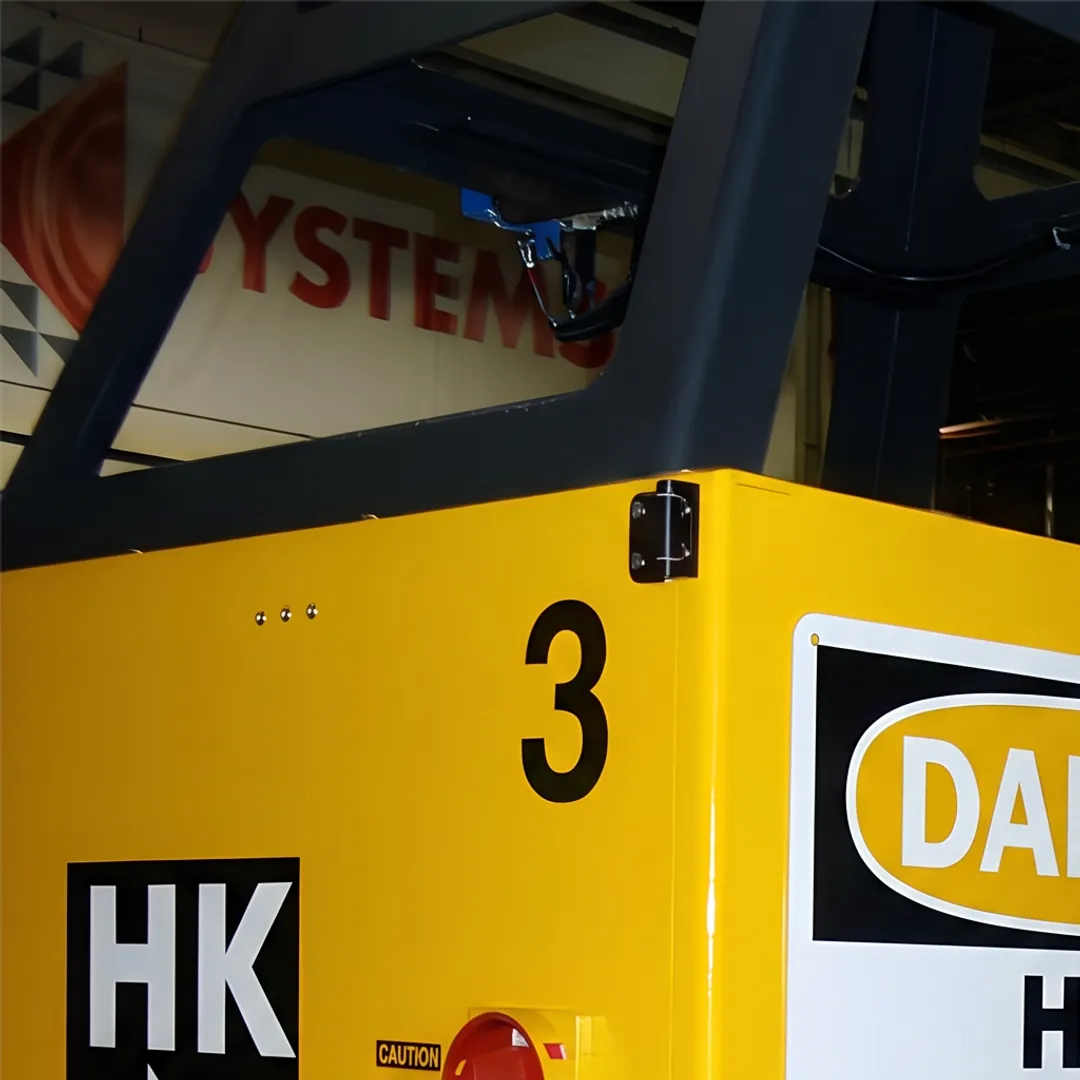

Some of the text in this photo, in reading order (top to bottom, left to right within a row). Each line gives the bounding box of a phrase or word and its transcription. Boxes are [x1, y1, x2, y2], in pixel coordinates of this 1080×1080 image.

[521, 599, 608, 803] 3
[89, 881, 297, 1058] HK
[378, 1043, 439, 1068] CAUTION
